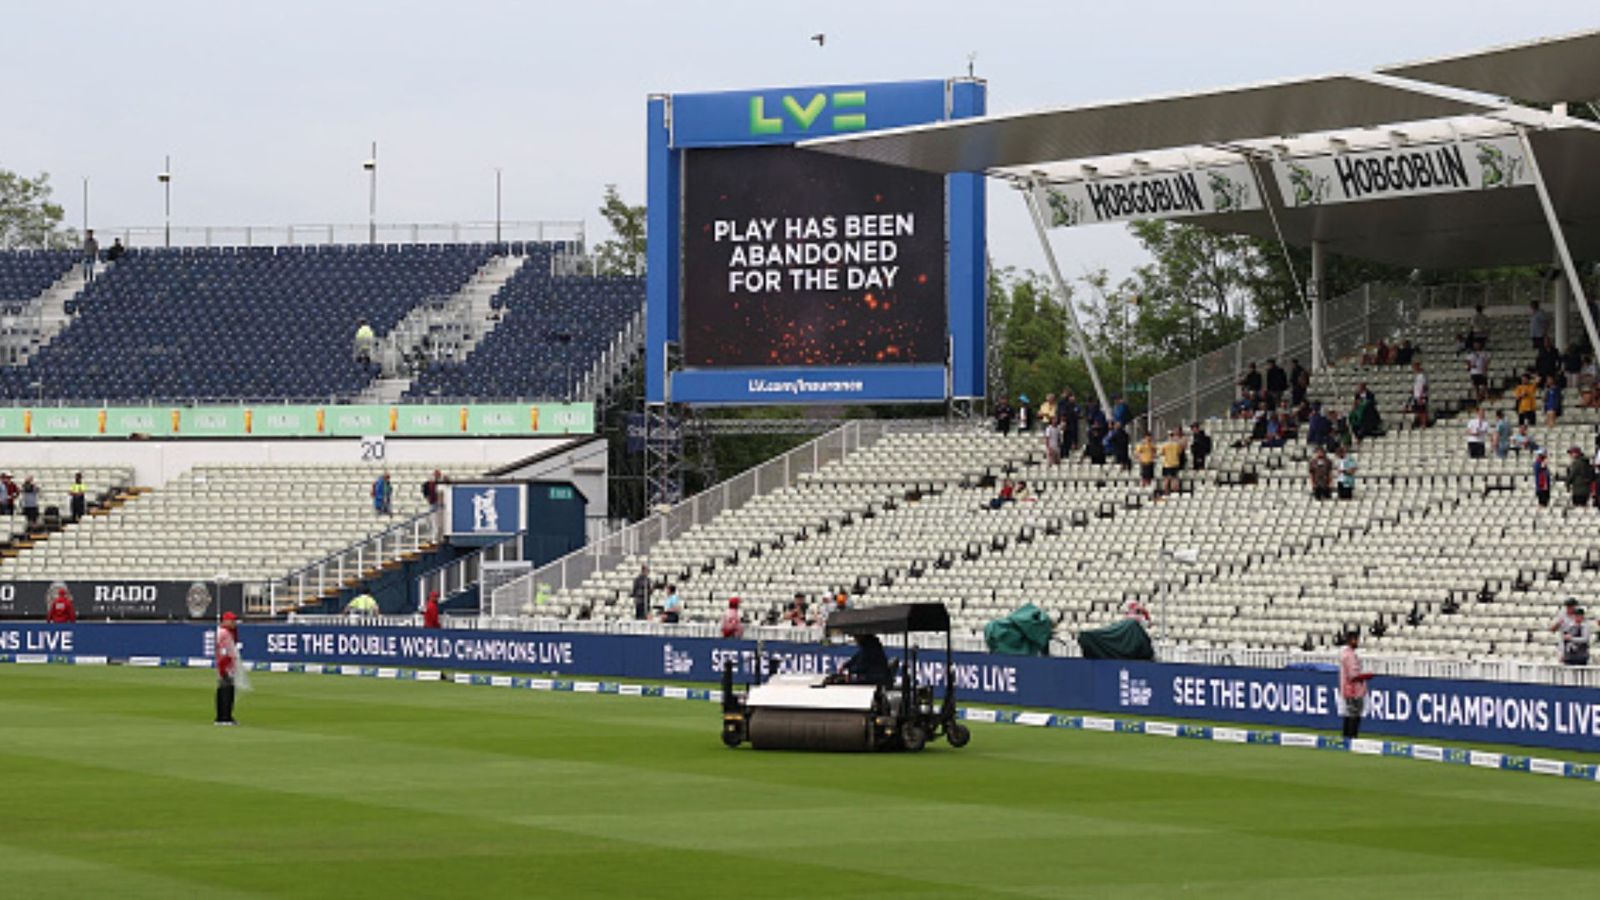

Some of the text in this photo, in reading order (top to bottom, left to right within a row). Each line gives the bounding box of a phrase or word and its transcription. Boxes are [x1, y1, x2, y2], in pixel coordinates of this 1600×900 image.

[1334, 144, 1470, 199] HOBGOBLIN
[1086, 171, 1204, 221] HOBGOBLIN
[714, 213, 915, 242] PLAY HAS BEEN
[729, 240, 898, 267] ABANDONED
[729, 265, 899, 293] FOR THE DAY
[361, 440, 384, 461] 20
[94, 585, 157, 602] RADO
[26, 630, 74, 650] LIVE
[267, 632, 573, 664] SEE THE DOUBLE WORLD CHAMPIONS LIVE
[983, 665, 1018, 693] LIVE
[1173, 676, 1206, 706] SEE
[1210, 678, 1246, 709] THE
[1250, 682, 1328, 715] DOUBLE
[1416, 692, 1549, 731] CHAMPIONS
[1555, 702, 1600, 735] LIVE
